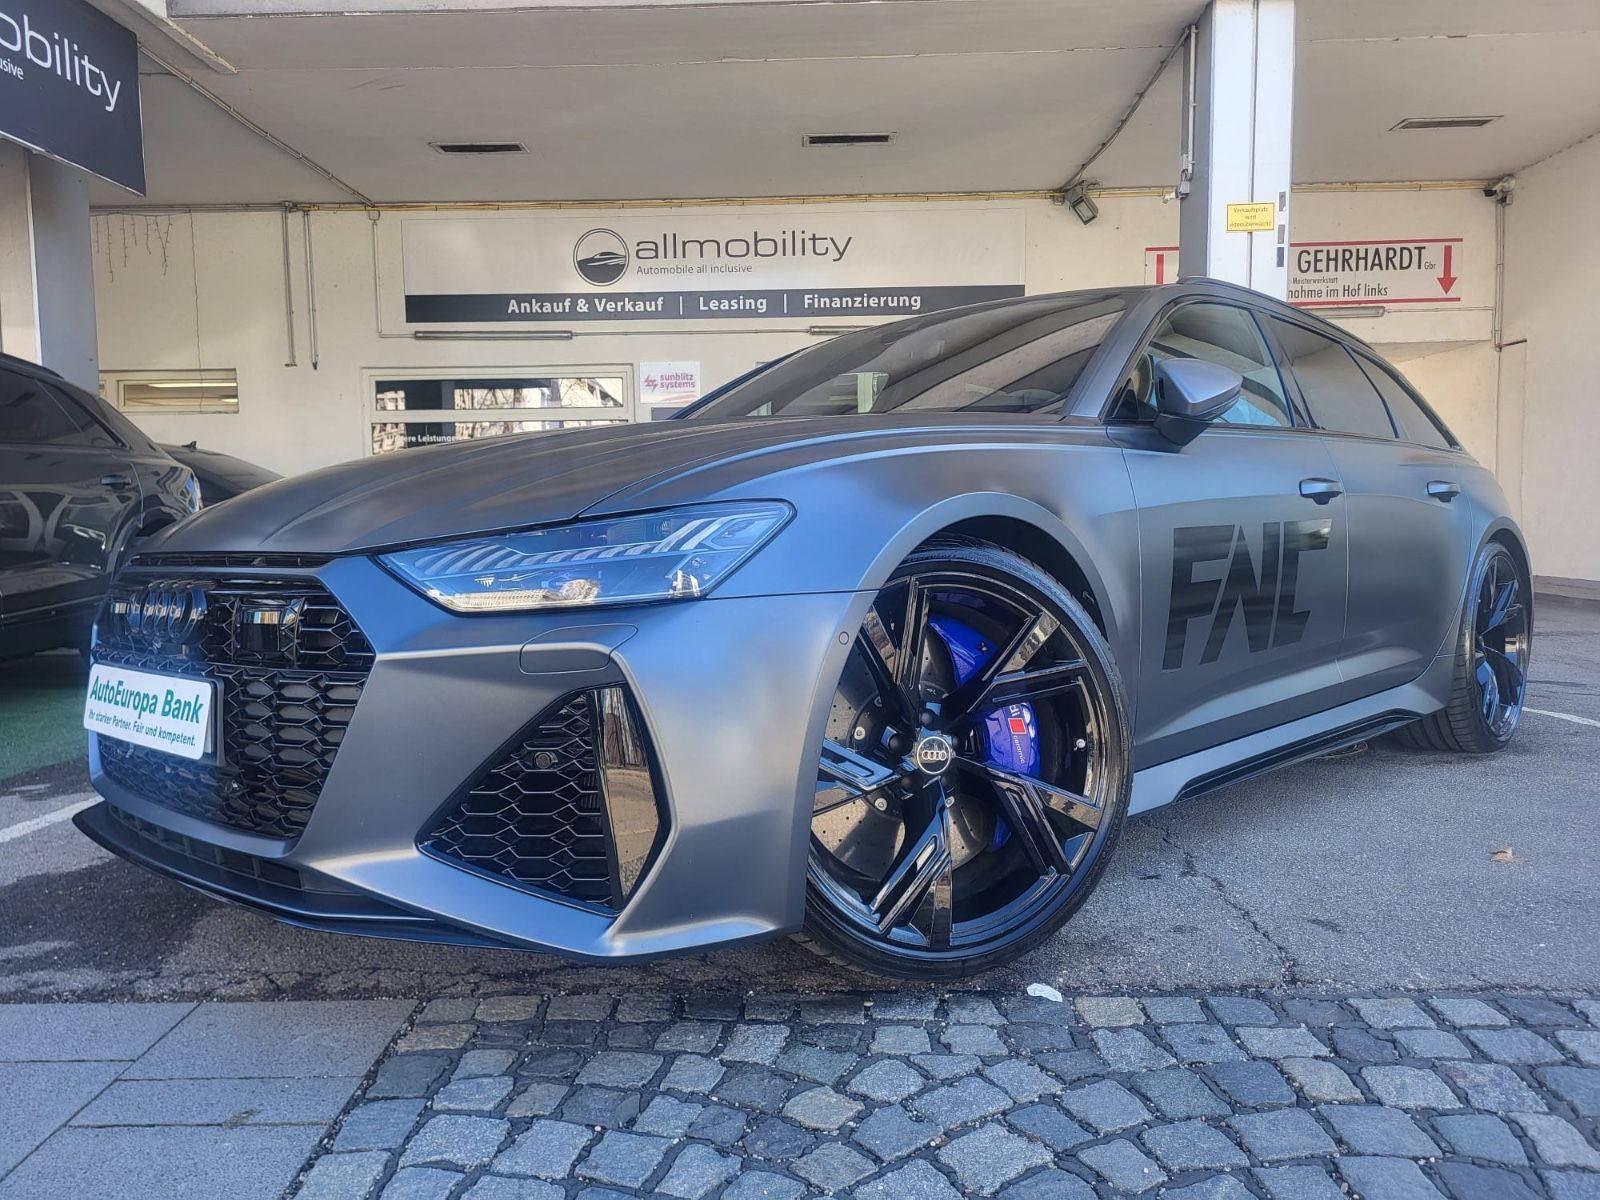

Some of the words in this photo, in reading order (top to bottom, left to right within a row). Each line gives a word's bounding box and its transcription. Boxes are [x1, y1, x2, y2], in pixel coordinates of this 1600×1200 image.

[635, 230, 853, 262] allmobility
[636, 264, 694, 276] Automobile
[696, 264, 708, 274] all
[710, 263, 753, 274] inclusive
[1297, 246, 1426, 274] GEHRHARDT
[1424, 260, 1437, 270] Gbr
[1292, 276, 1338, 285] Meisterwerkstatt
[1326, 286, 1339, 298] im
[1343, 283, 1361, 297] Hof
[1364, 282, 1388, 297] links
[507, 298, 572, 314] Ankauf
[576, 298, 589, 313] &
[594, 296, 664, 312] Verkauf
[700, 296, 768, 313] Leasing
[804, 293, 921, 310] Finanzierung
[660, 372, 694, 381] sunblitz
[660, 380, 696, 391] systems
[90, 675, 158, 720] AutoEuropa
[161, 688, 204, 724] Bank
[95, 711, 113, 724] starker
[112, 715, 132, 731] Partner.
[132, 721, 145, 734] Fair
[145, 724, 157, 737] und
[157, 726, 196, 747] kompetent.
[1013, 734, 1025, 764] ceramic
